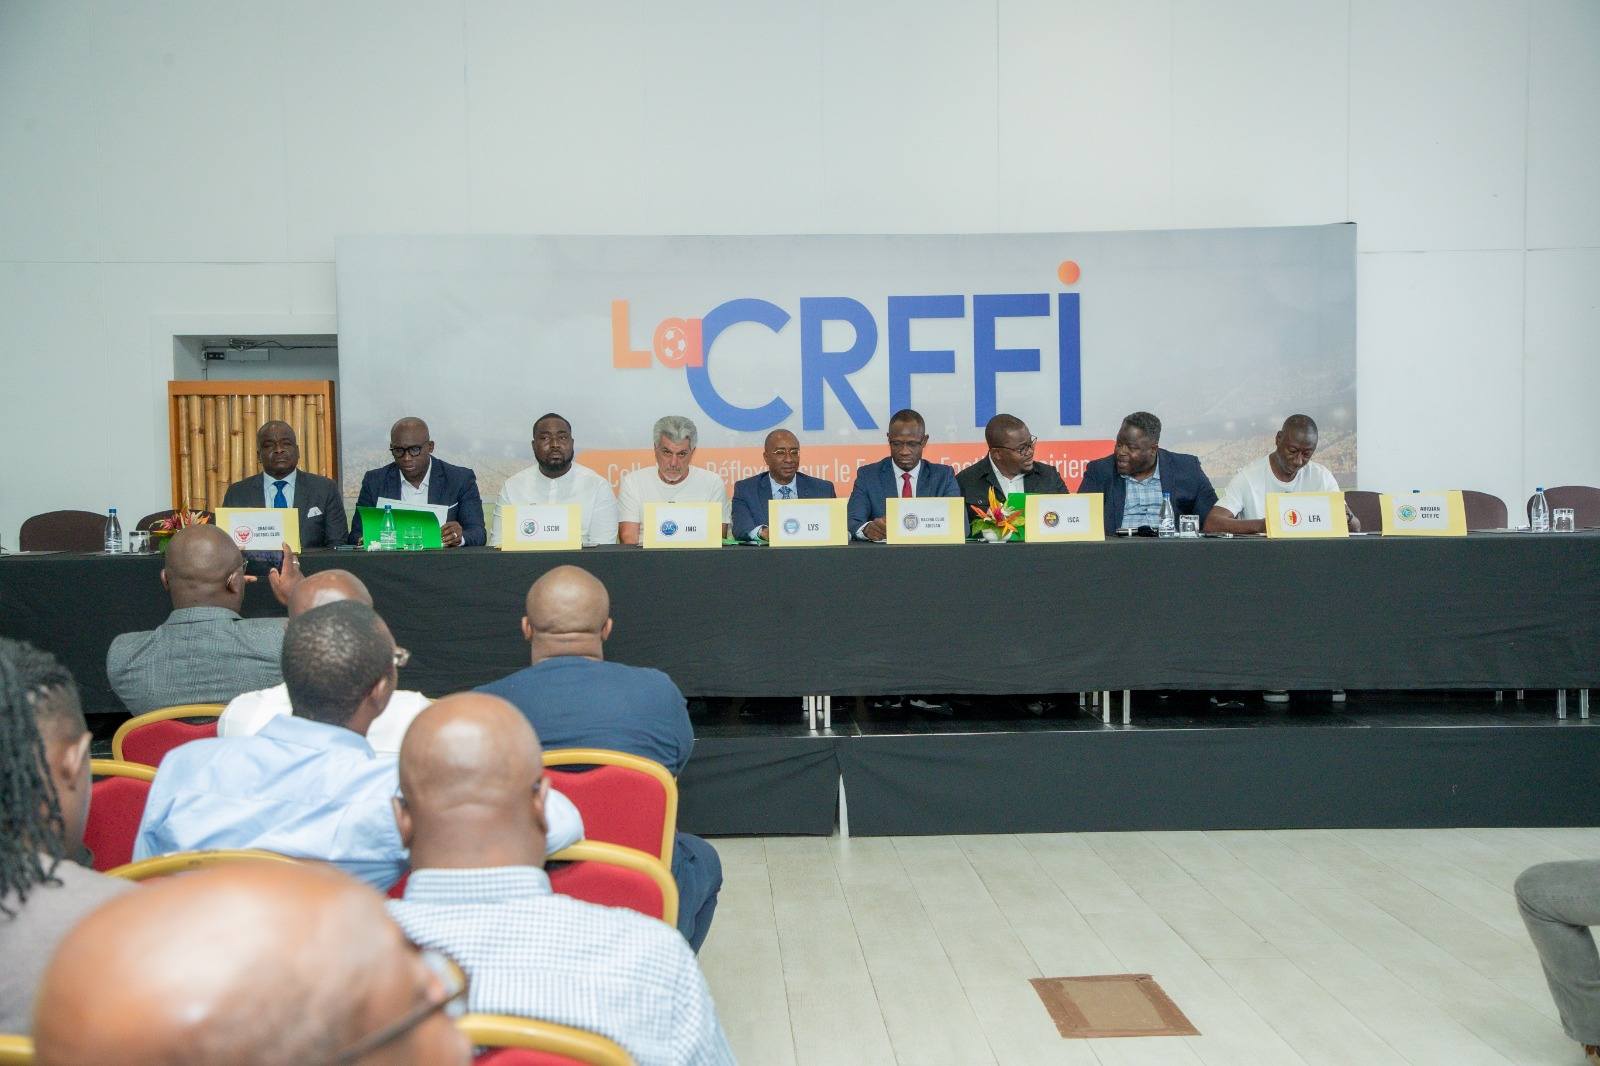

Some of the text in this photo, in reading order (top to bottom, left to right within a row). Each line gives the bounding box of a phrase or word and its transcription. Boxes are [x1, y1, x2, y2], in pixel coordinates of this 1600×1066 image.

[833, 459, 851, 483] le
[1308, 514, 1321, 523] LFA
[807, 523, 820, 531] LYS
